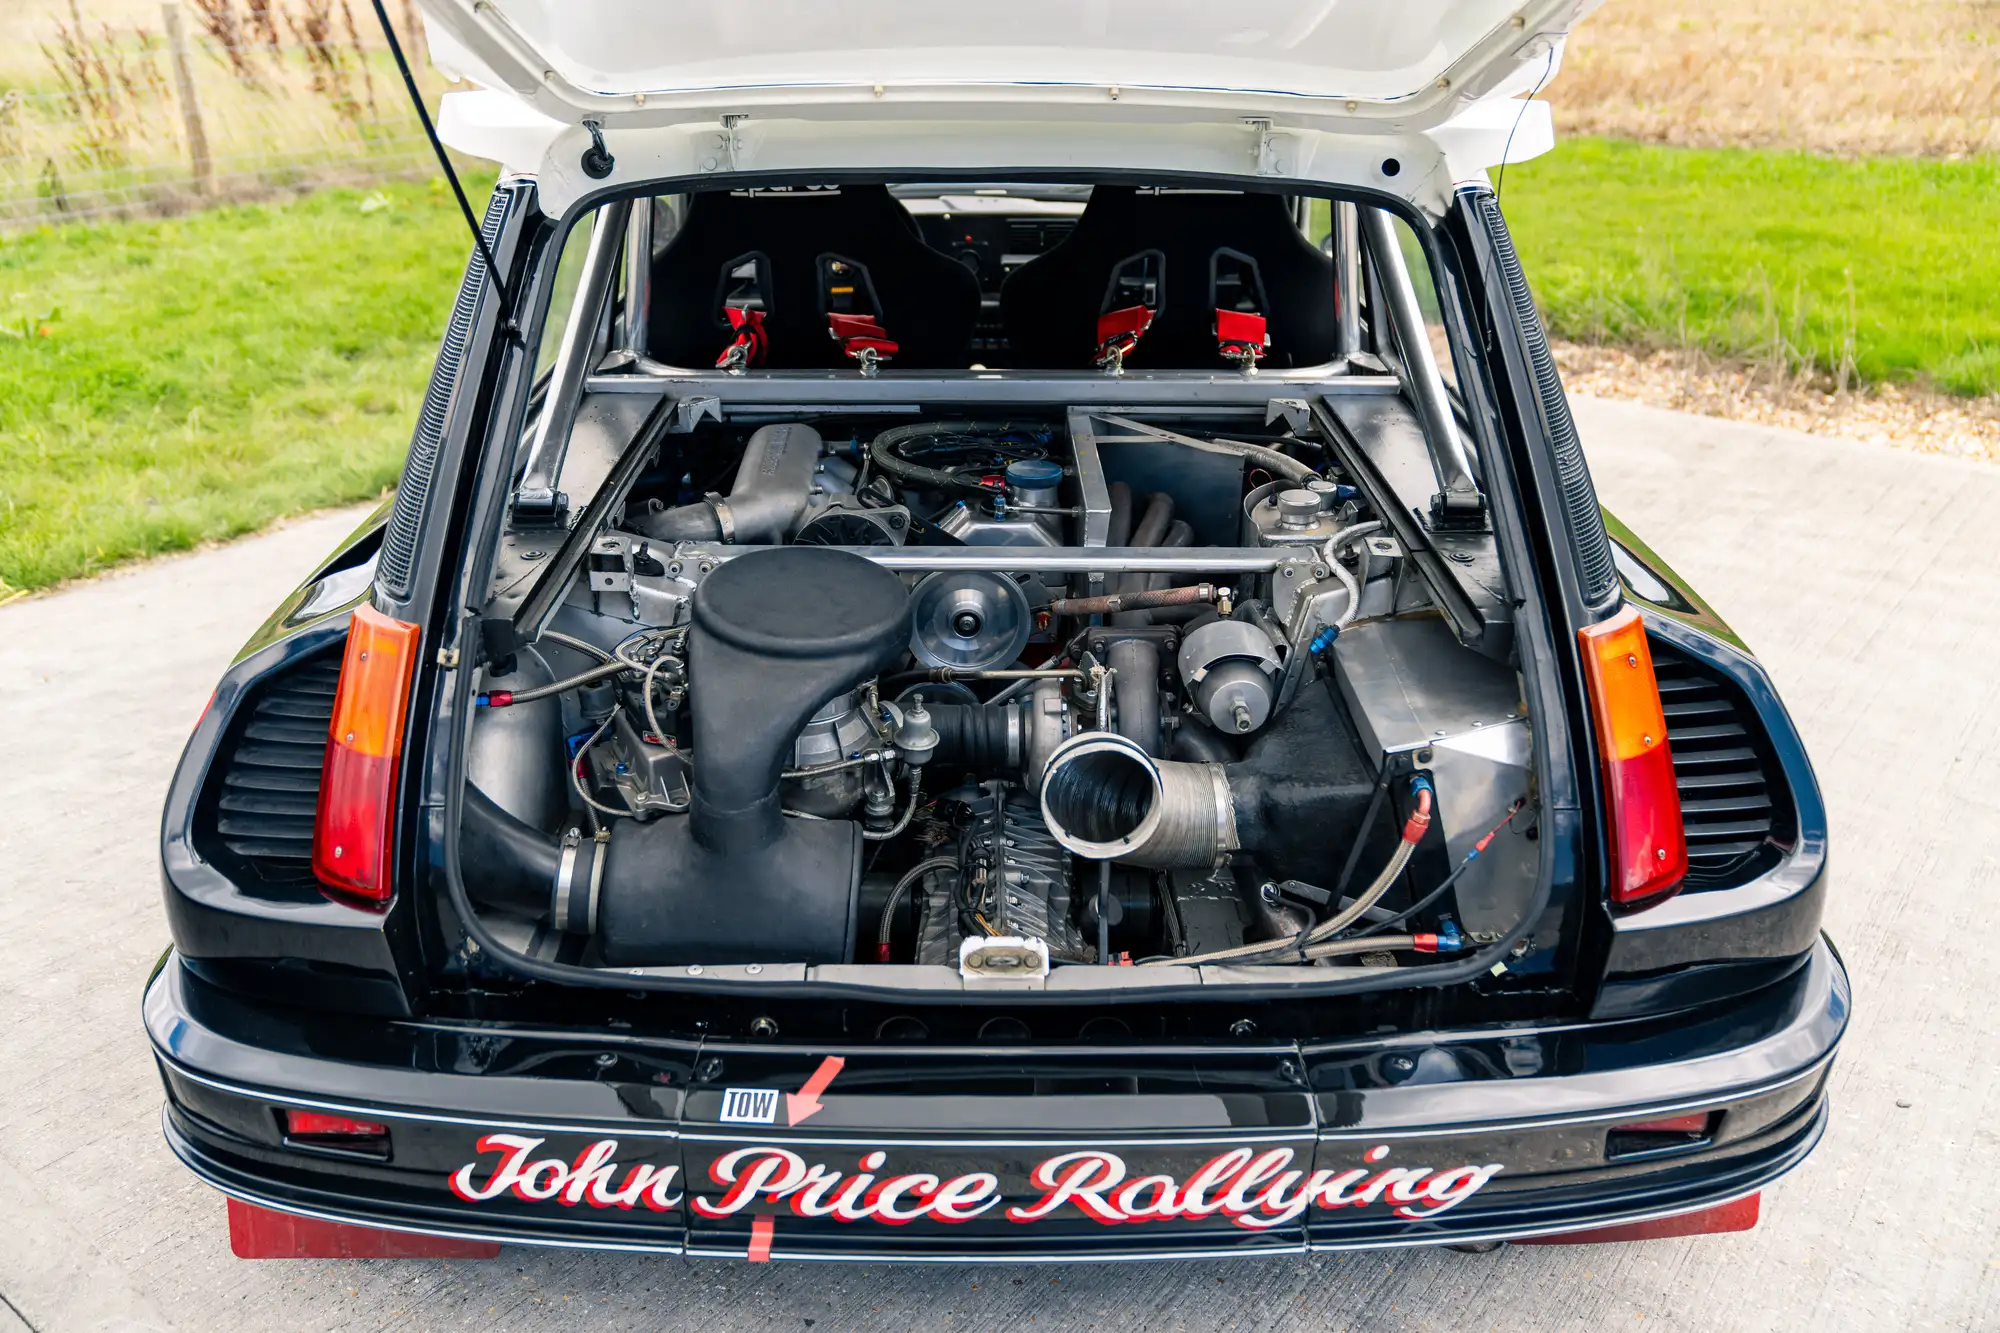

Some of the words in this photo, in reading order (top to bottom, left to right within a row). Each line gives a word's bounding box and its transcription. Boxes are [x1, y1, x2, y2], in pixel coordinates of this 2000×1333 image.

[727, 1091, 774, 1118] TOW
[449, 1134, 683, 1212] John
[692, 1147, 1001, 1224] Price
[1005, 1144, 1504, 1230] Rallying
